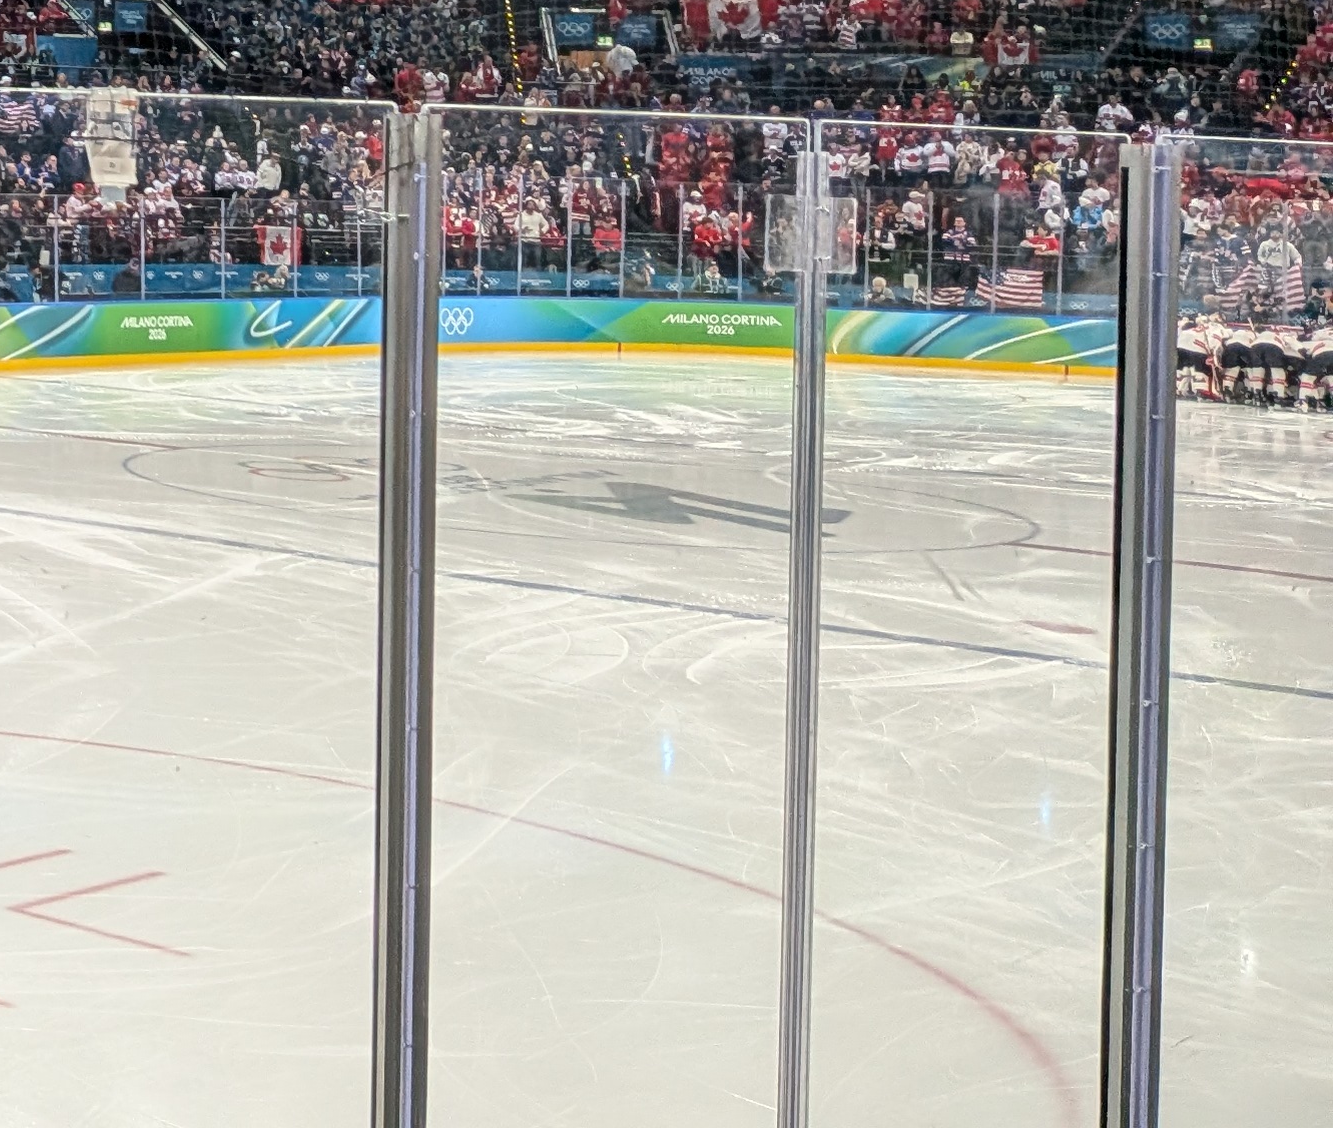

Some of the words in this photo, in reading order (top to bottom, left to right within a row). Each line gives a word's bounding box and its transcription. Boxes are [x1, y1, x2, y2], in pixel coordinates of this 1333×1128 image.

[120, 316, 157, 328] MILANO
[157, 315, 194, 327] CORTINA
[661, 313, 720, 324] MILANO
[721, 313, 783, 327] CORTINA
[706, 324, 736, 336] 2026
